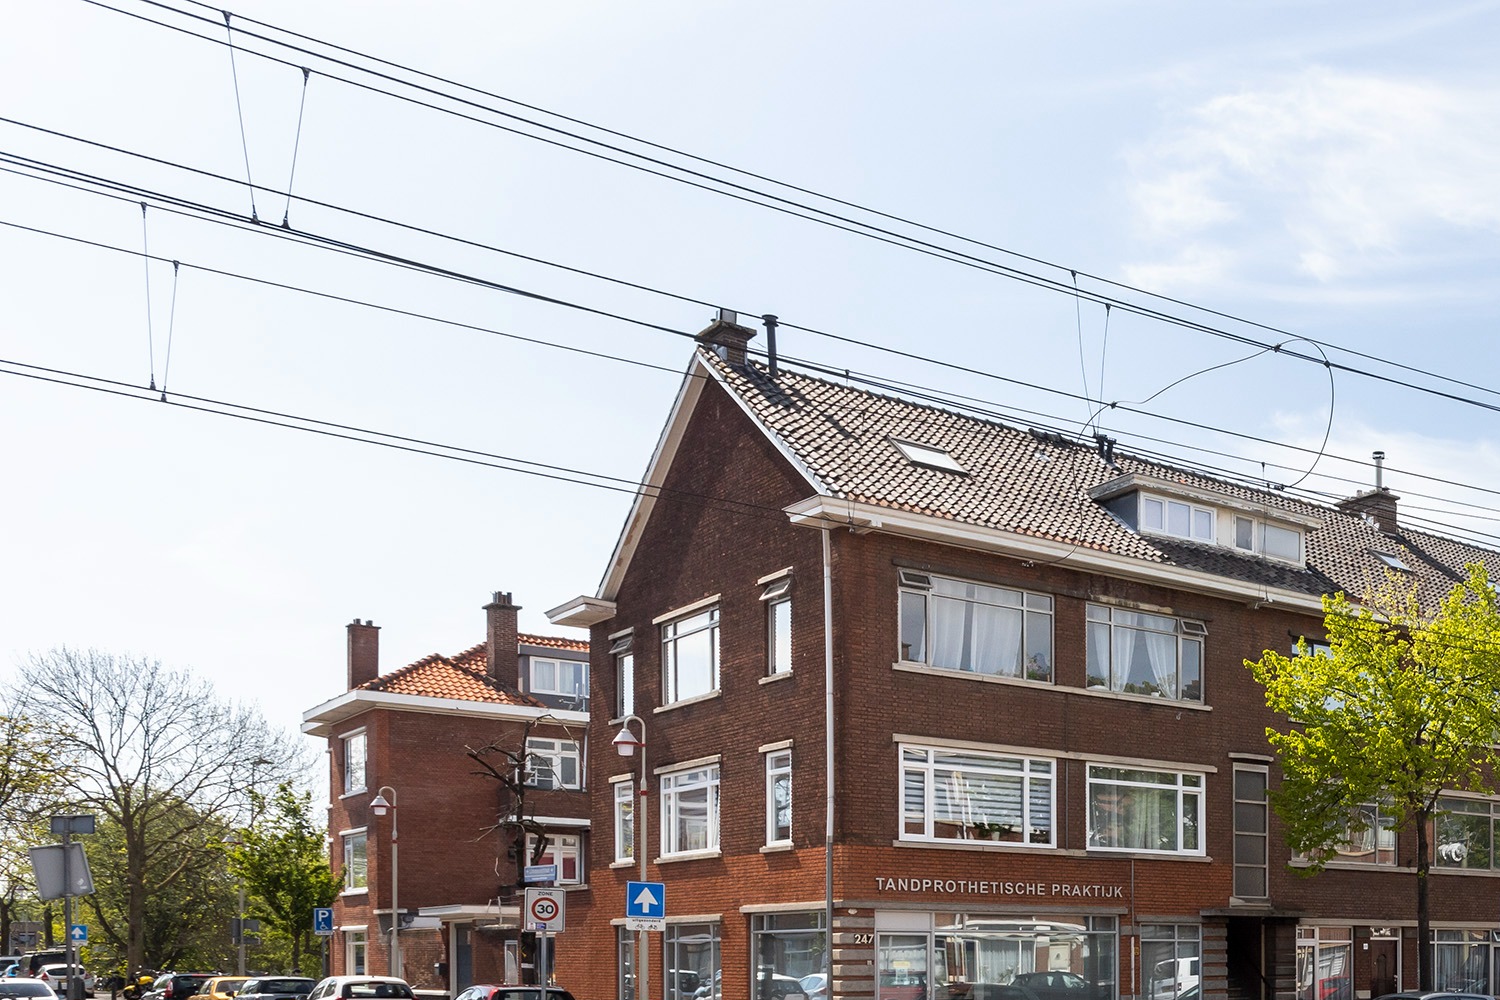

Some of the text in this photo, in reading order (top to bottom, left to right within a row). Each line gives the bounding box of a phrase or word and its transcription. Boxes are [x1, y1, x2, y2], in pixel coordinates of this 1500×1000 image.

[875, 877, 1124, 898] TANDPROTHETISCHE PRAKTIJK
[537, 904, 554, 914] 30
[318, 910, 329, 922] P
[854, 933, 875, 944] 247
